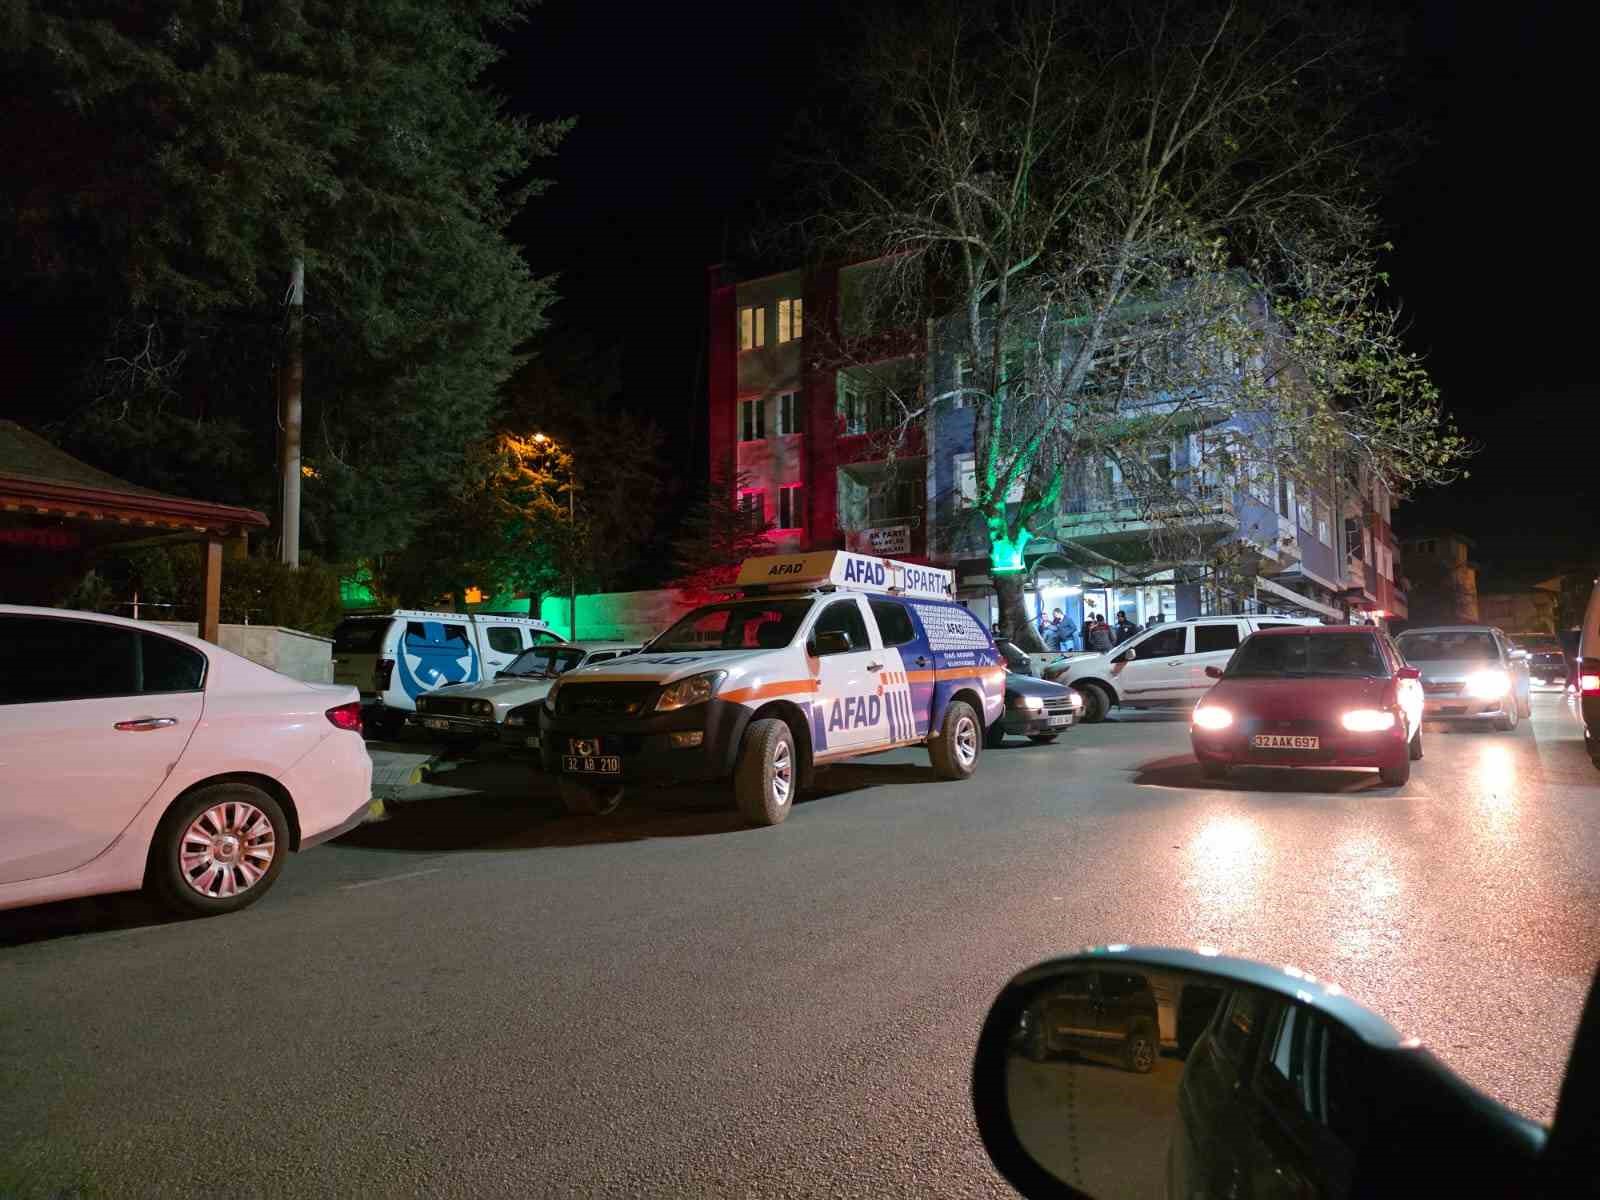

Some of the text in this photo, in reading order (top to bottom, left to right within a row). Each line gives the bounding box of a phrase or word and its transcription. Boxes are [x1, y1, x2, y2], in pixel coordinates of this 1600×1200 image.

[768, 563, 803, 576] AFAD
[844, 558, 886, 586] AFAD
[828, 694, 881, 732] AFAD
[600, 757, 618, 772] 210
